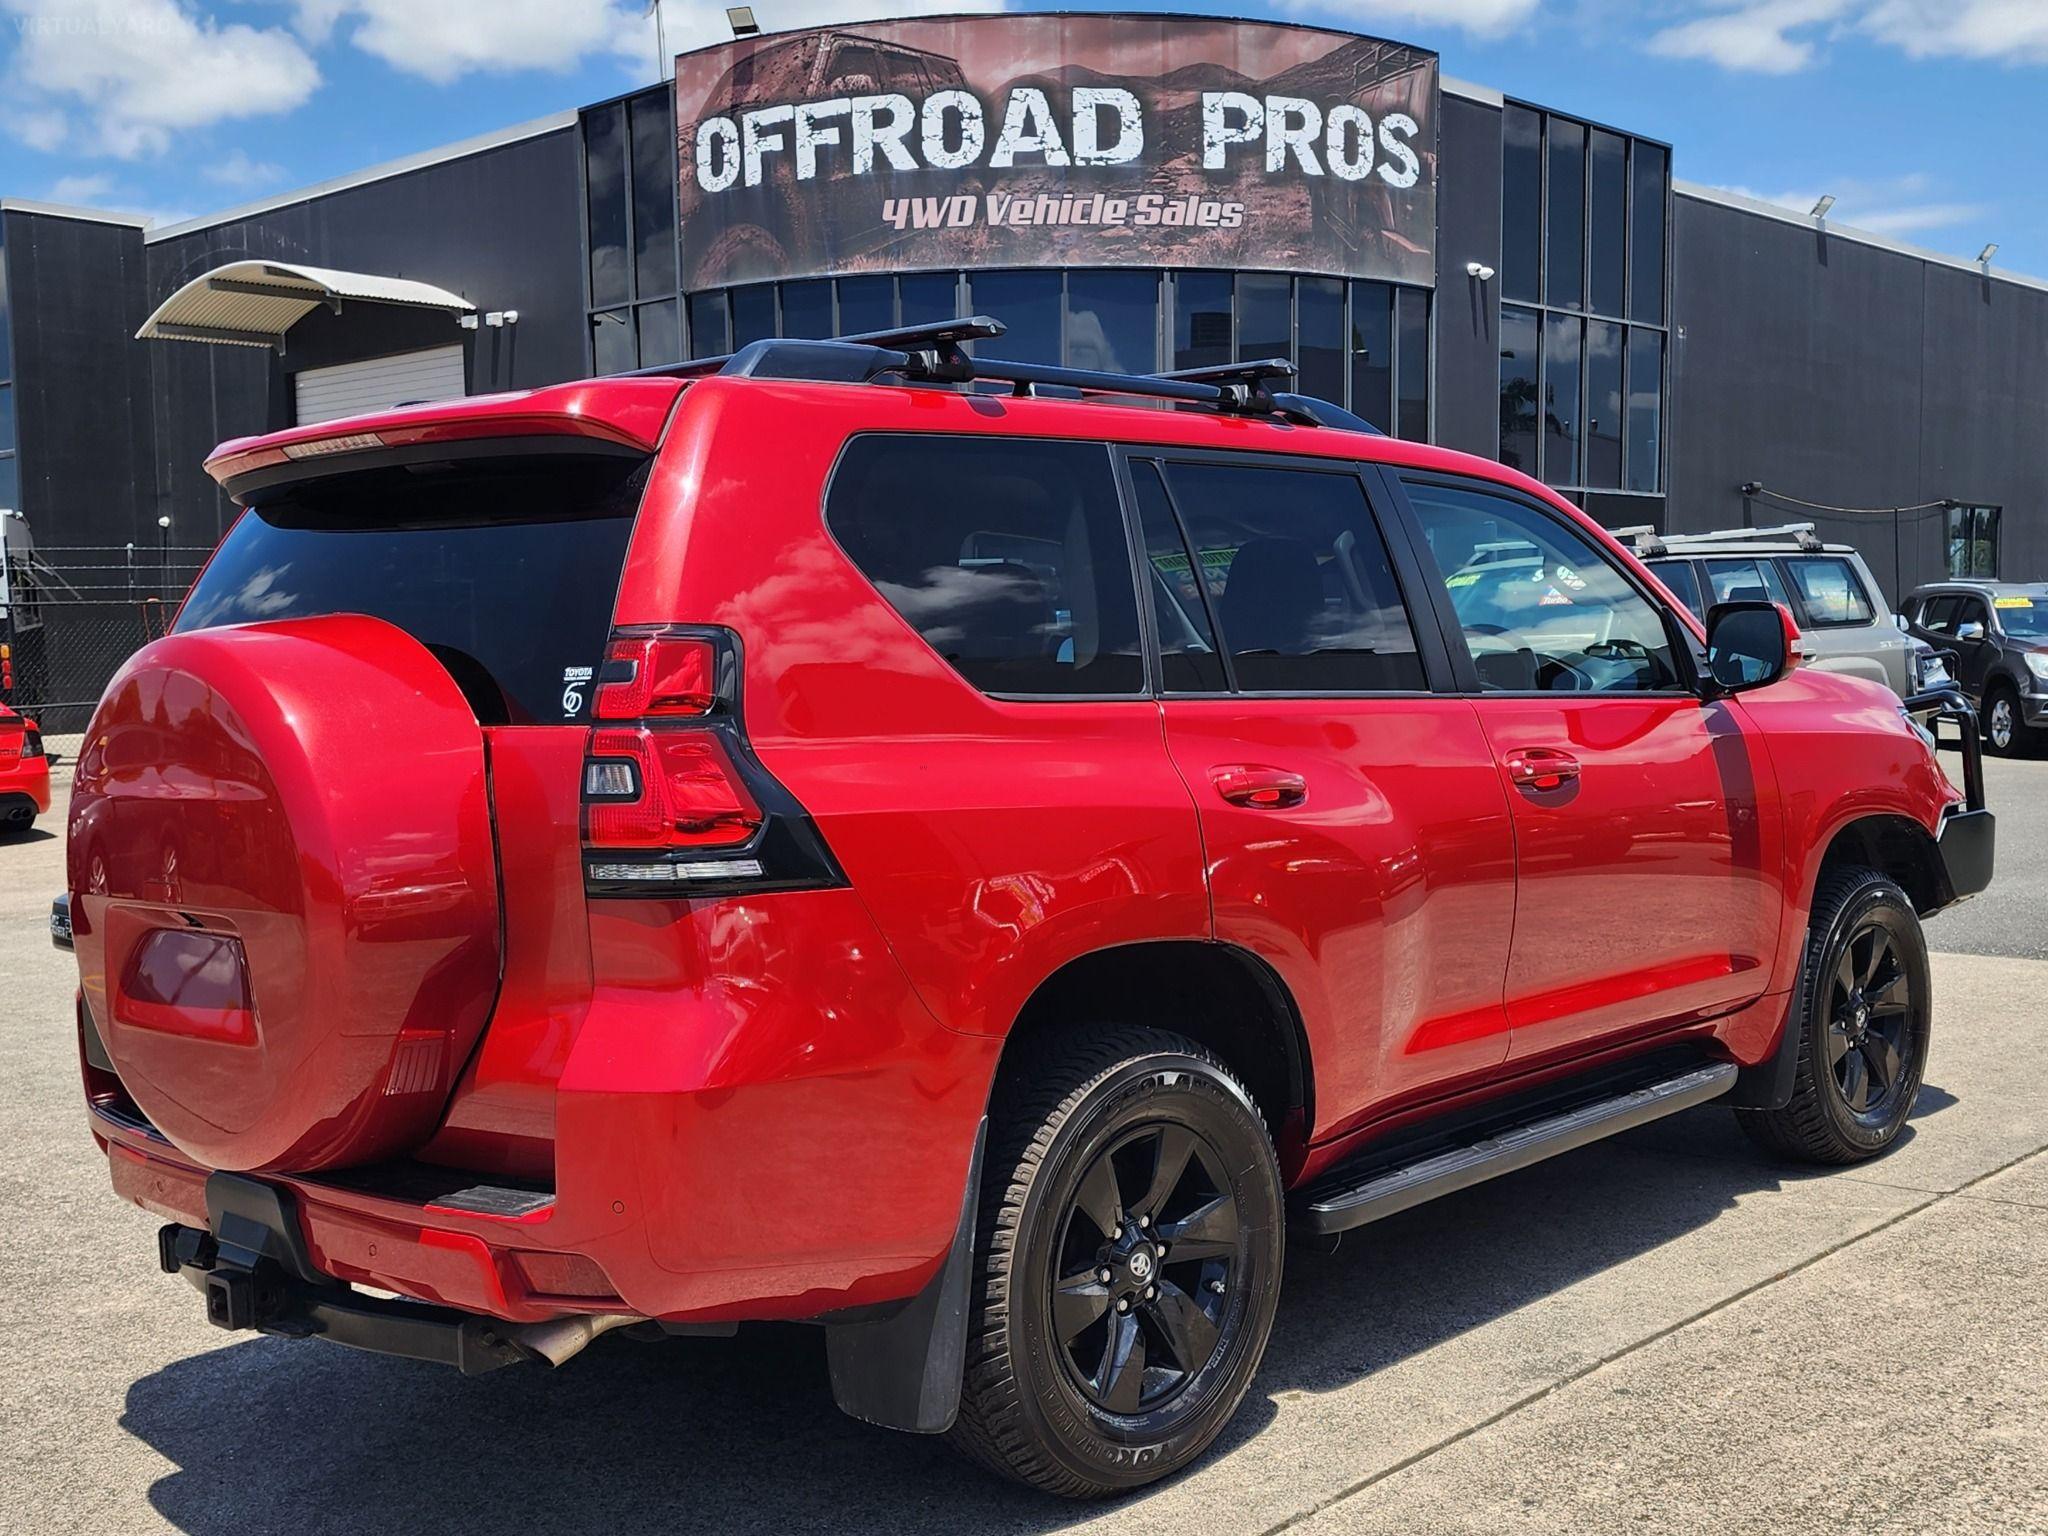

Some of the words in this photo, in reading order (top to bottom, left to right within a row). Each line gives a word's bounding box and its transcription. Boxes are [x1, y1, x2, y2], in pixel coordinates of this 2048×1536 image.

[696, 87, 1144, 192] OFFROAD
[1202, 91, 1420, 188] PROS
[882, 195, 977, 230] 4WD
[985, 193, 1126, 228] Vehicle
[1133, 193, 1245, 229] Sales
[564, 666, 592, 677] TOYOTA
